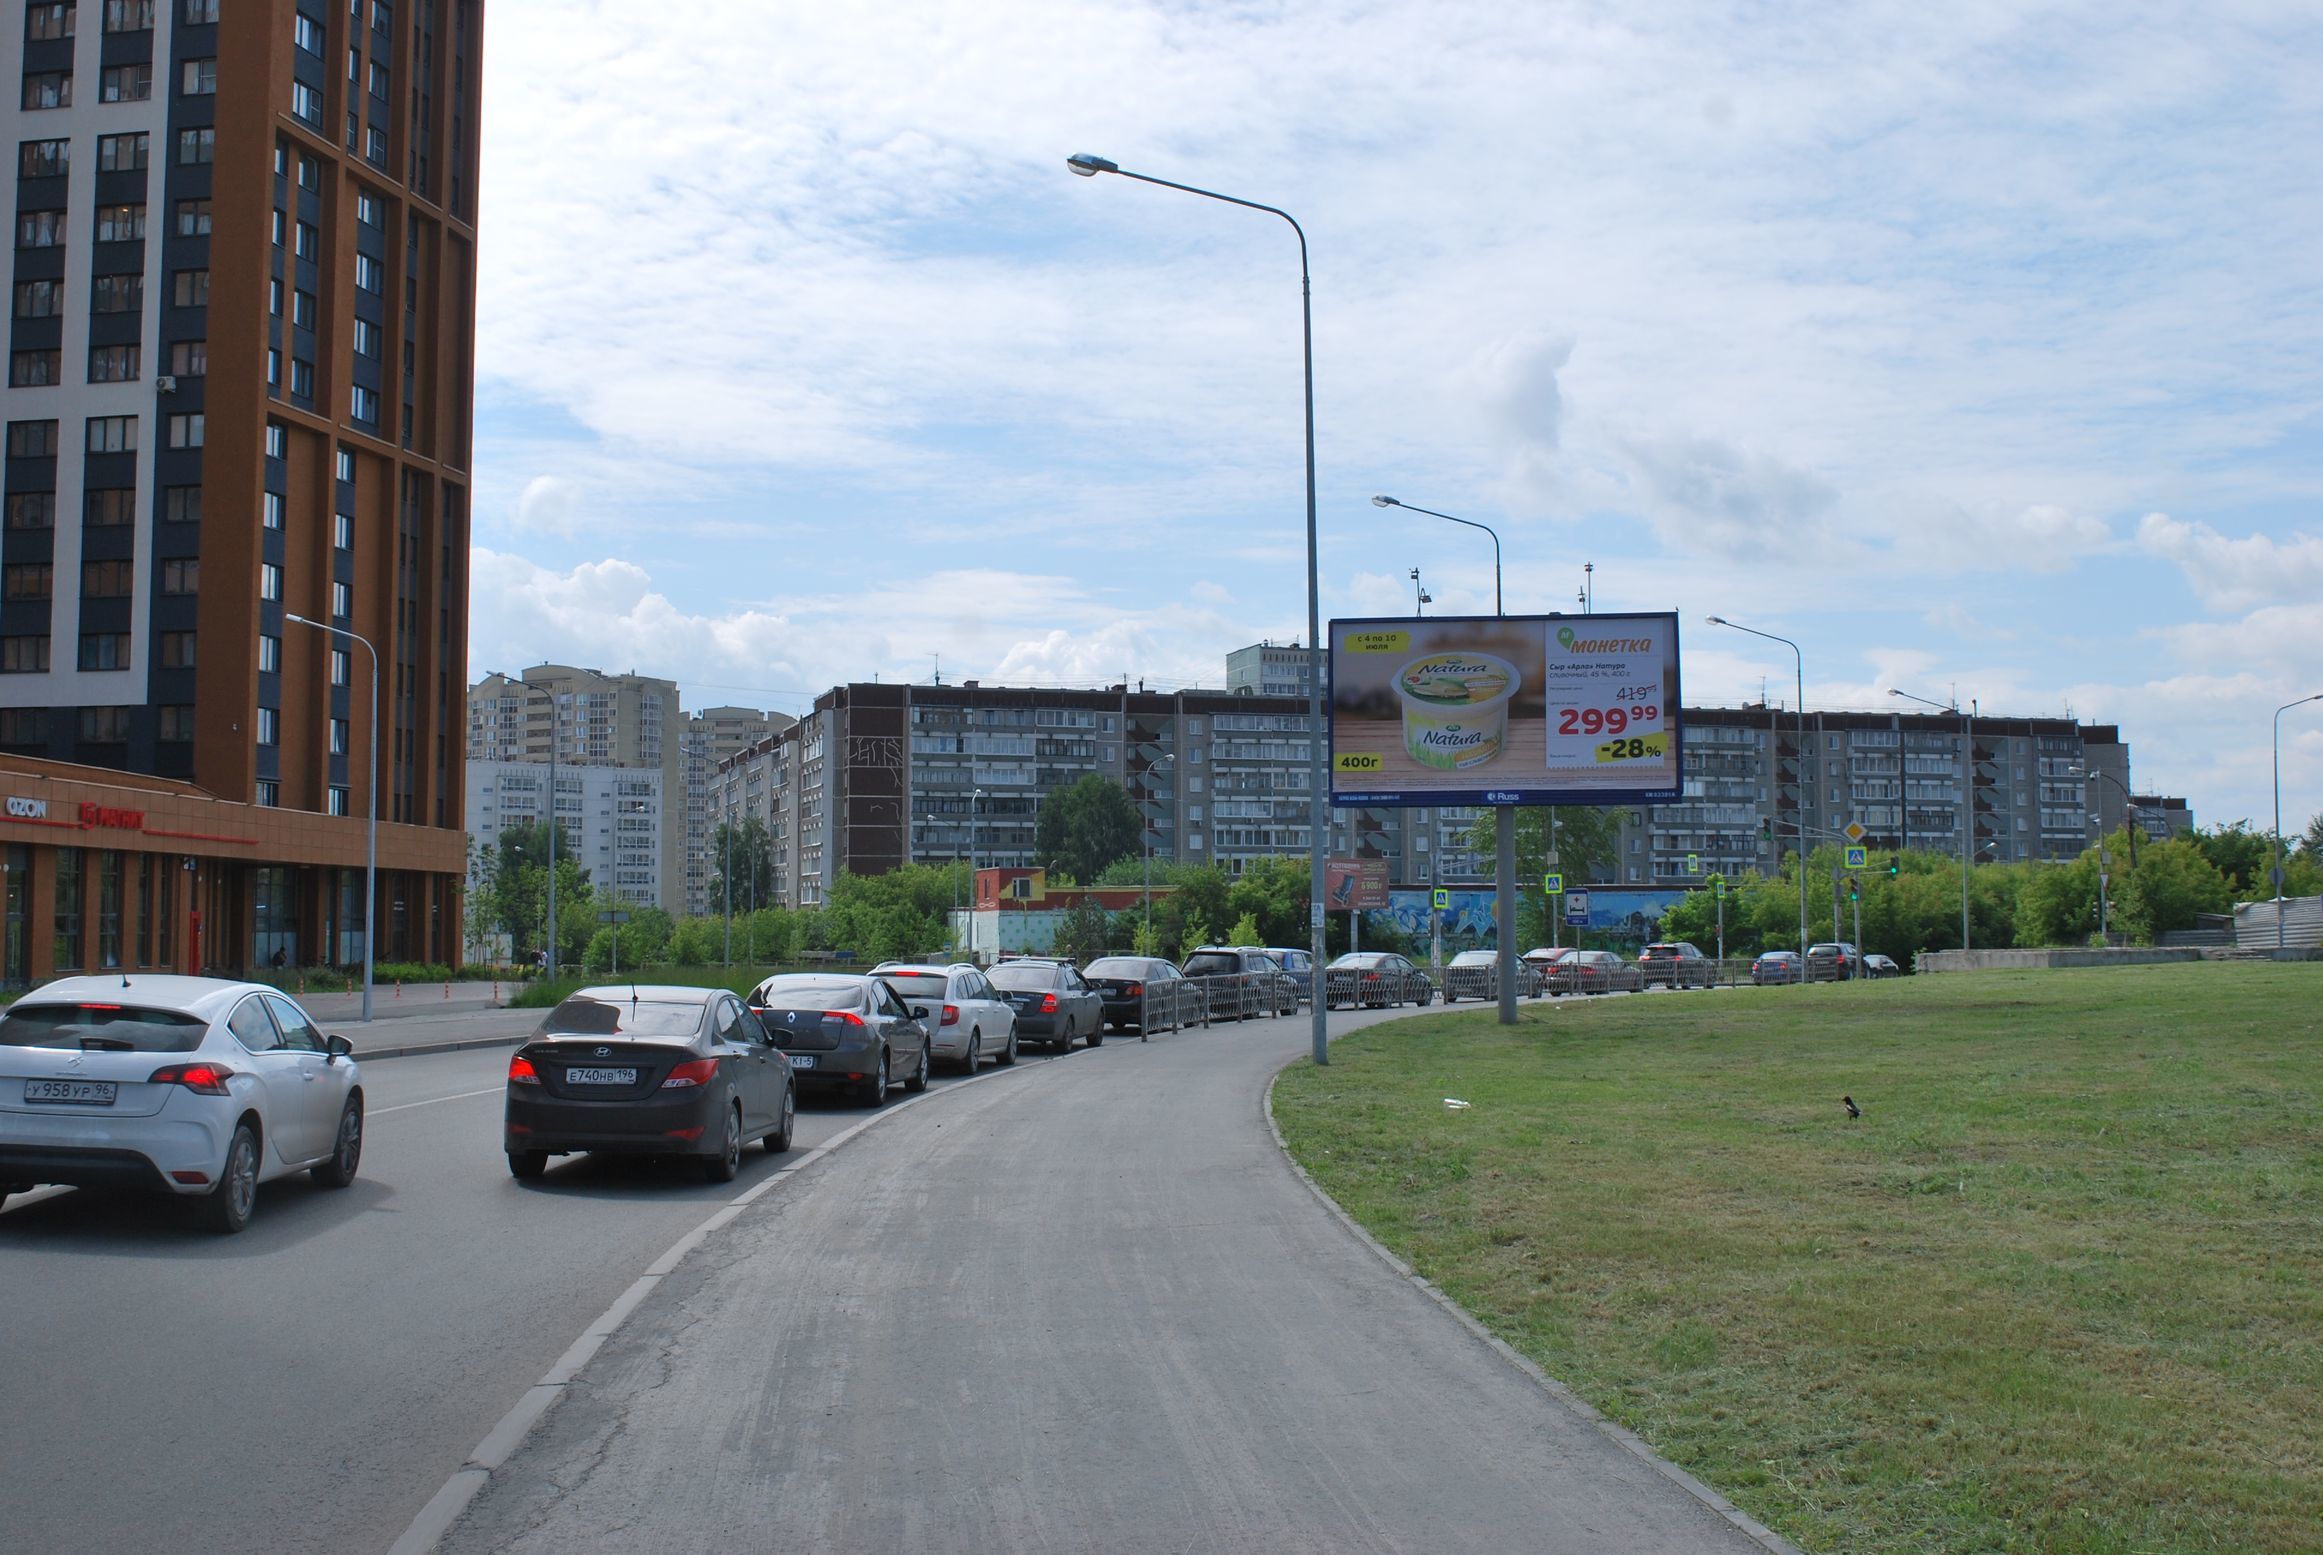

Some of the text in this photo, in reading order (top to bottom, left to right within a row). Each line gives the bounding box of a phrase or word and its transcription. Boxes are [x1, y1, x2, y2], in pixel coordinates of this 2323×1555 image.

[1386, 634, 1397, 642] 10
[1418, 664, 1488, 675] Natura
[1549, 663, 1565, 671] Сыр
[1595, 662, 1626, 671] Натура
[1590, 670, 1600, 678] 45
[1616, 686, 1648, 701] 419
[1558, 705, 1658, 735] 299 99
[1423, 730, 1481, 746] Natura
[1341, 756, 1378, 768] 400г
[1497, 792, 1520, 801] Russ
[6, 796, 47, 818] OZON
